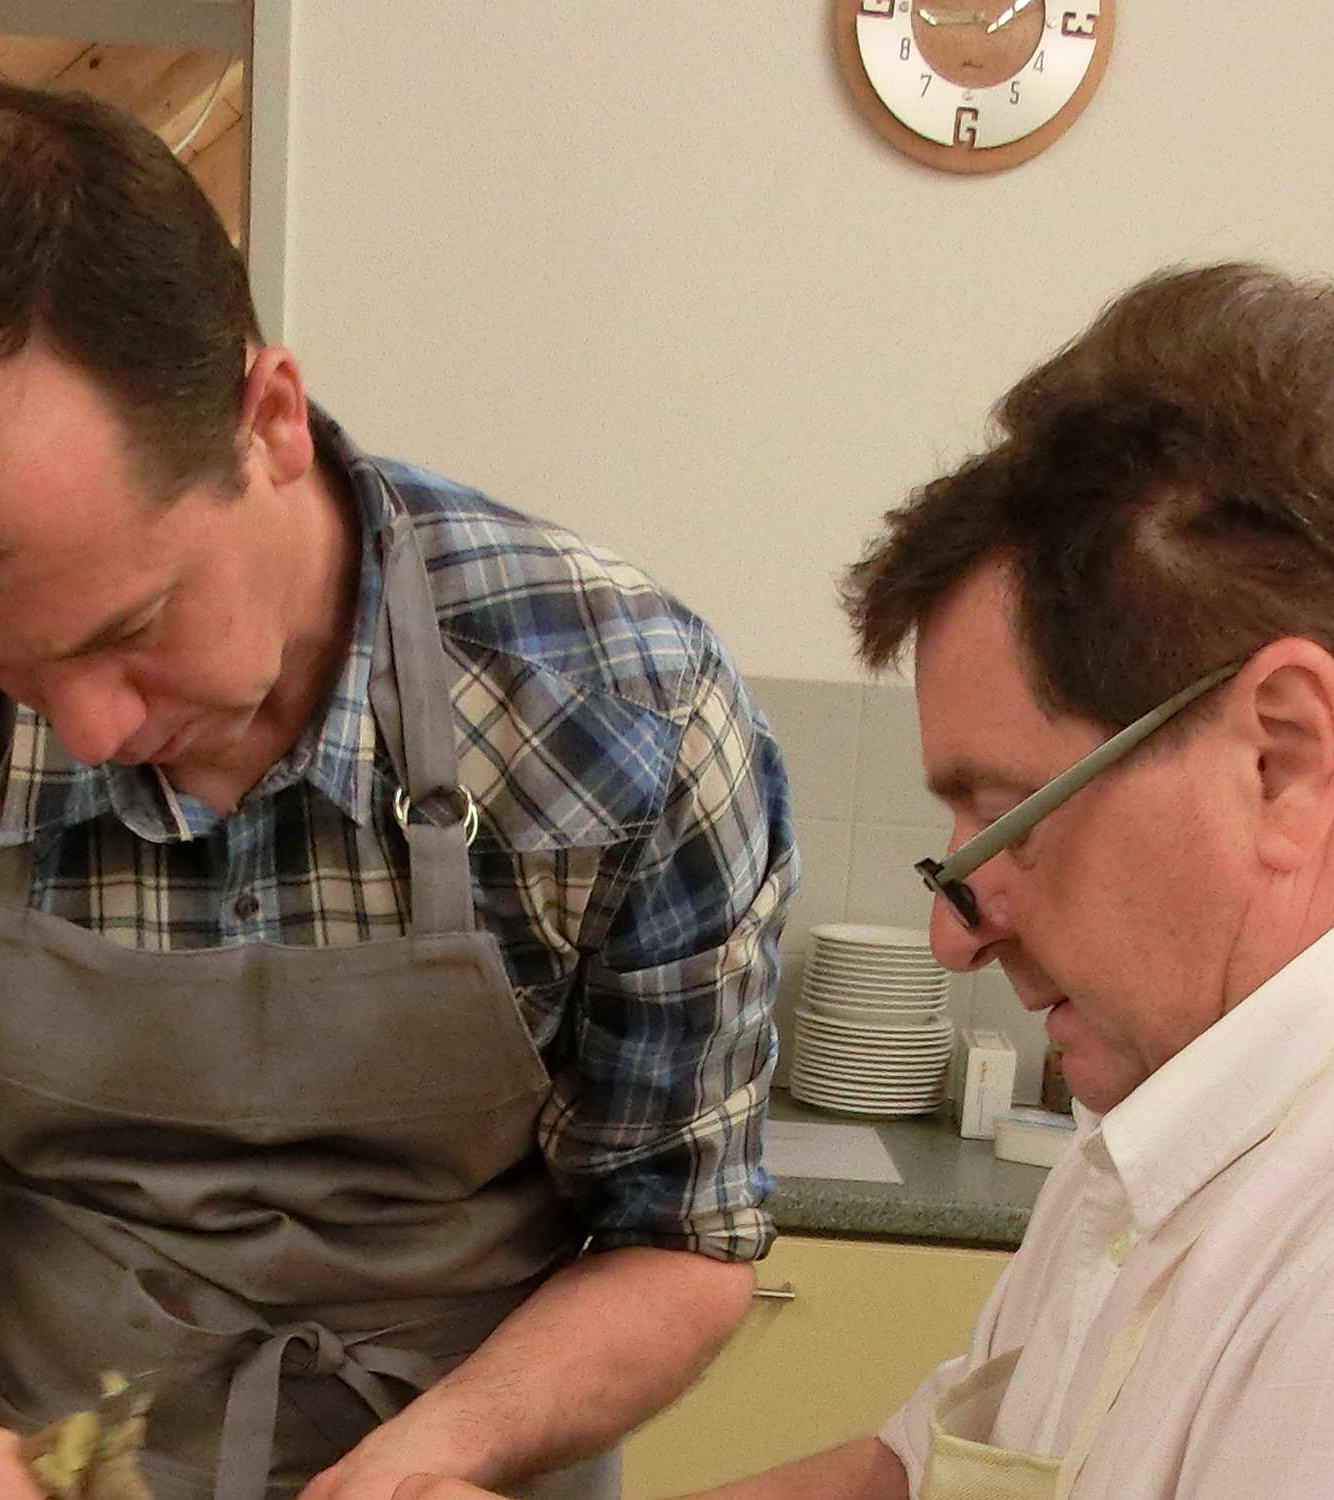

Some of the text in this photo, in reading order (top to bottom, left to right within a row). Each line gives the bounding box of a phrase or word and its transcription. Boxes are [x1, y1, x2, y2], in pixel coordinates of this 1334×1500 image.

[900, 37, 911, 61] 8
[1033, 50, 1045, 73] 4
[919, 74, 933, 98] 7
[1009, 80, 1020, 105] 5
